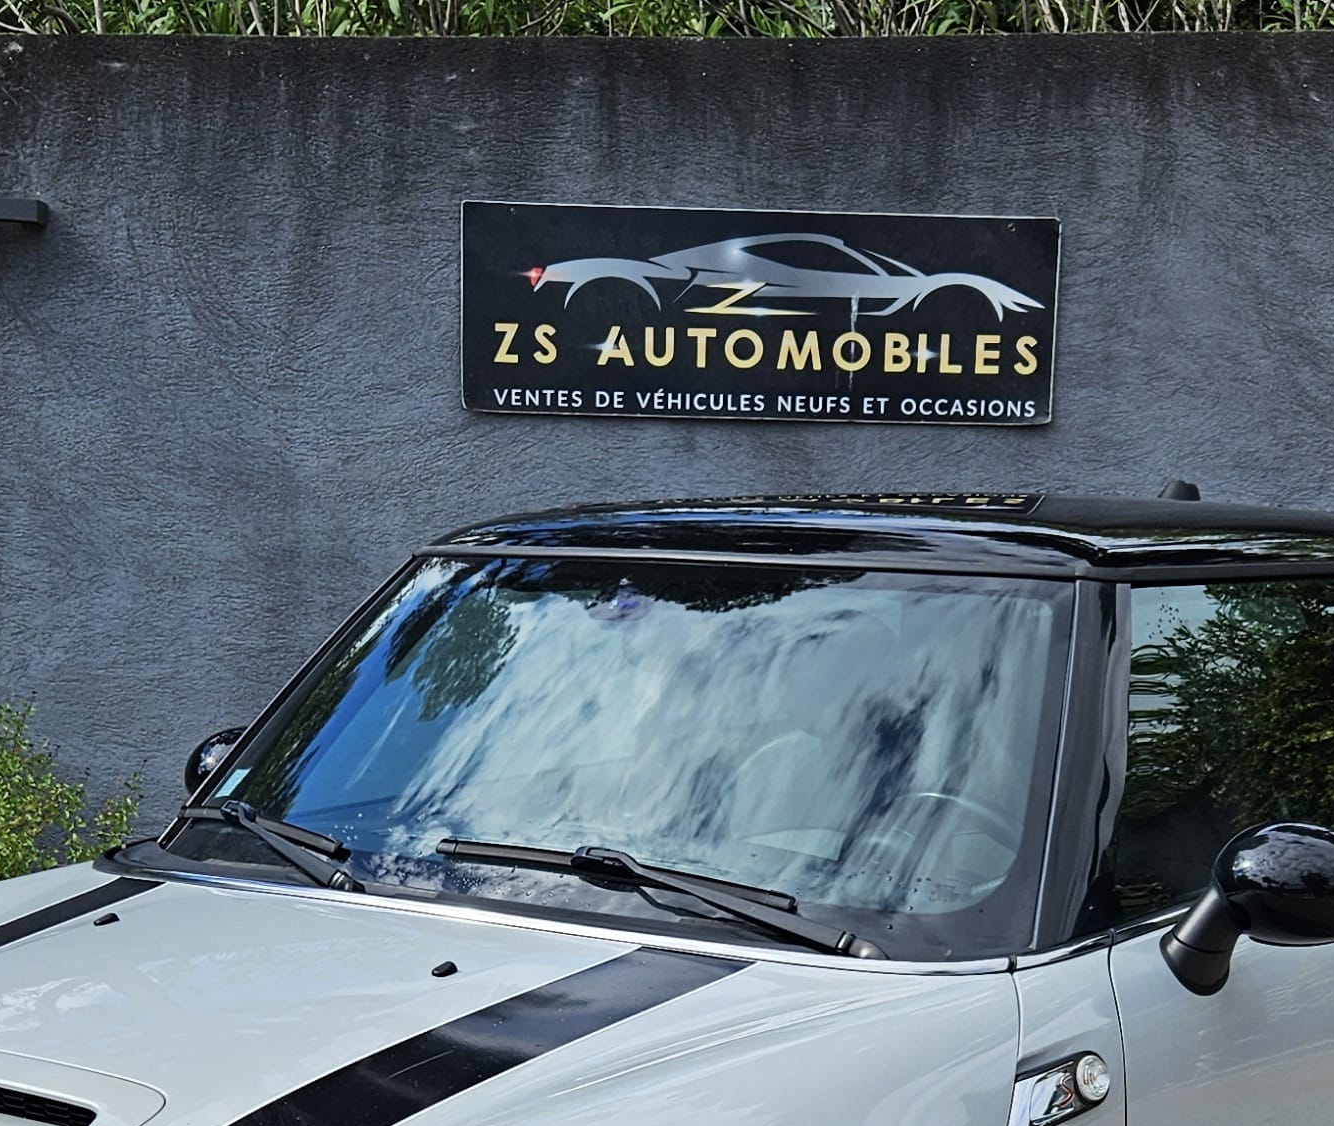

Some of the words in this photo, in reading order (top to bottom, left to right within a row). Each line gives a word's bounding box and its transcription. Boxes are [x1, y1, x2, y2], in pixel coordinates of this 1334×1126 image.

[493, 322, 557, 365] ZS
[597, 325, 1039, 375] AUTOMOBILES
[492, 387, 583, 408] VENTES
[595, 390, 625, 409] DE
[636, 388, 765, 412] VÉHICULES
[777, 395, 851, 414] NEUFS
[862, 397, 890, 415] ET
[900, 397, 1036, 417] OCCASIONS
